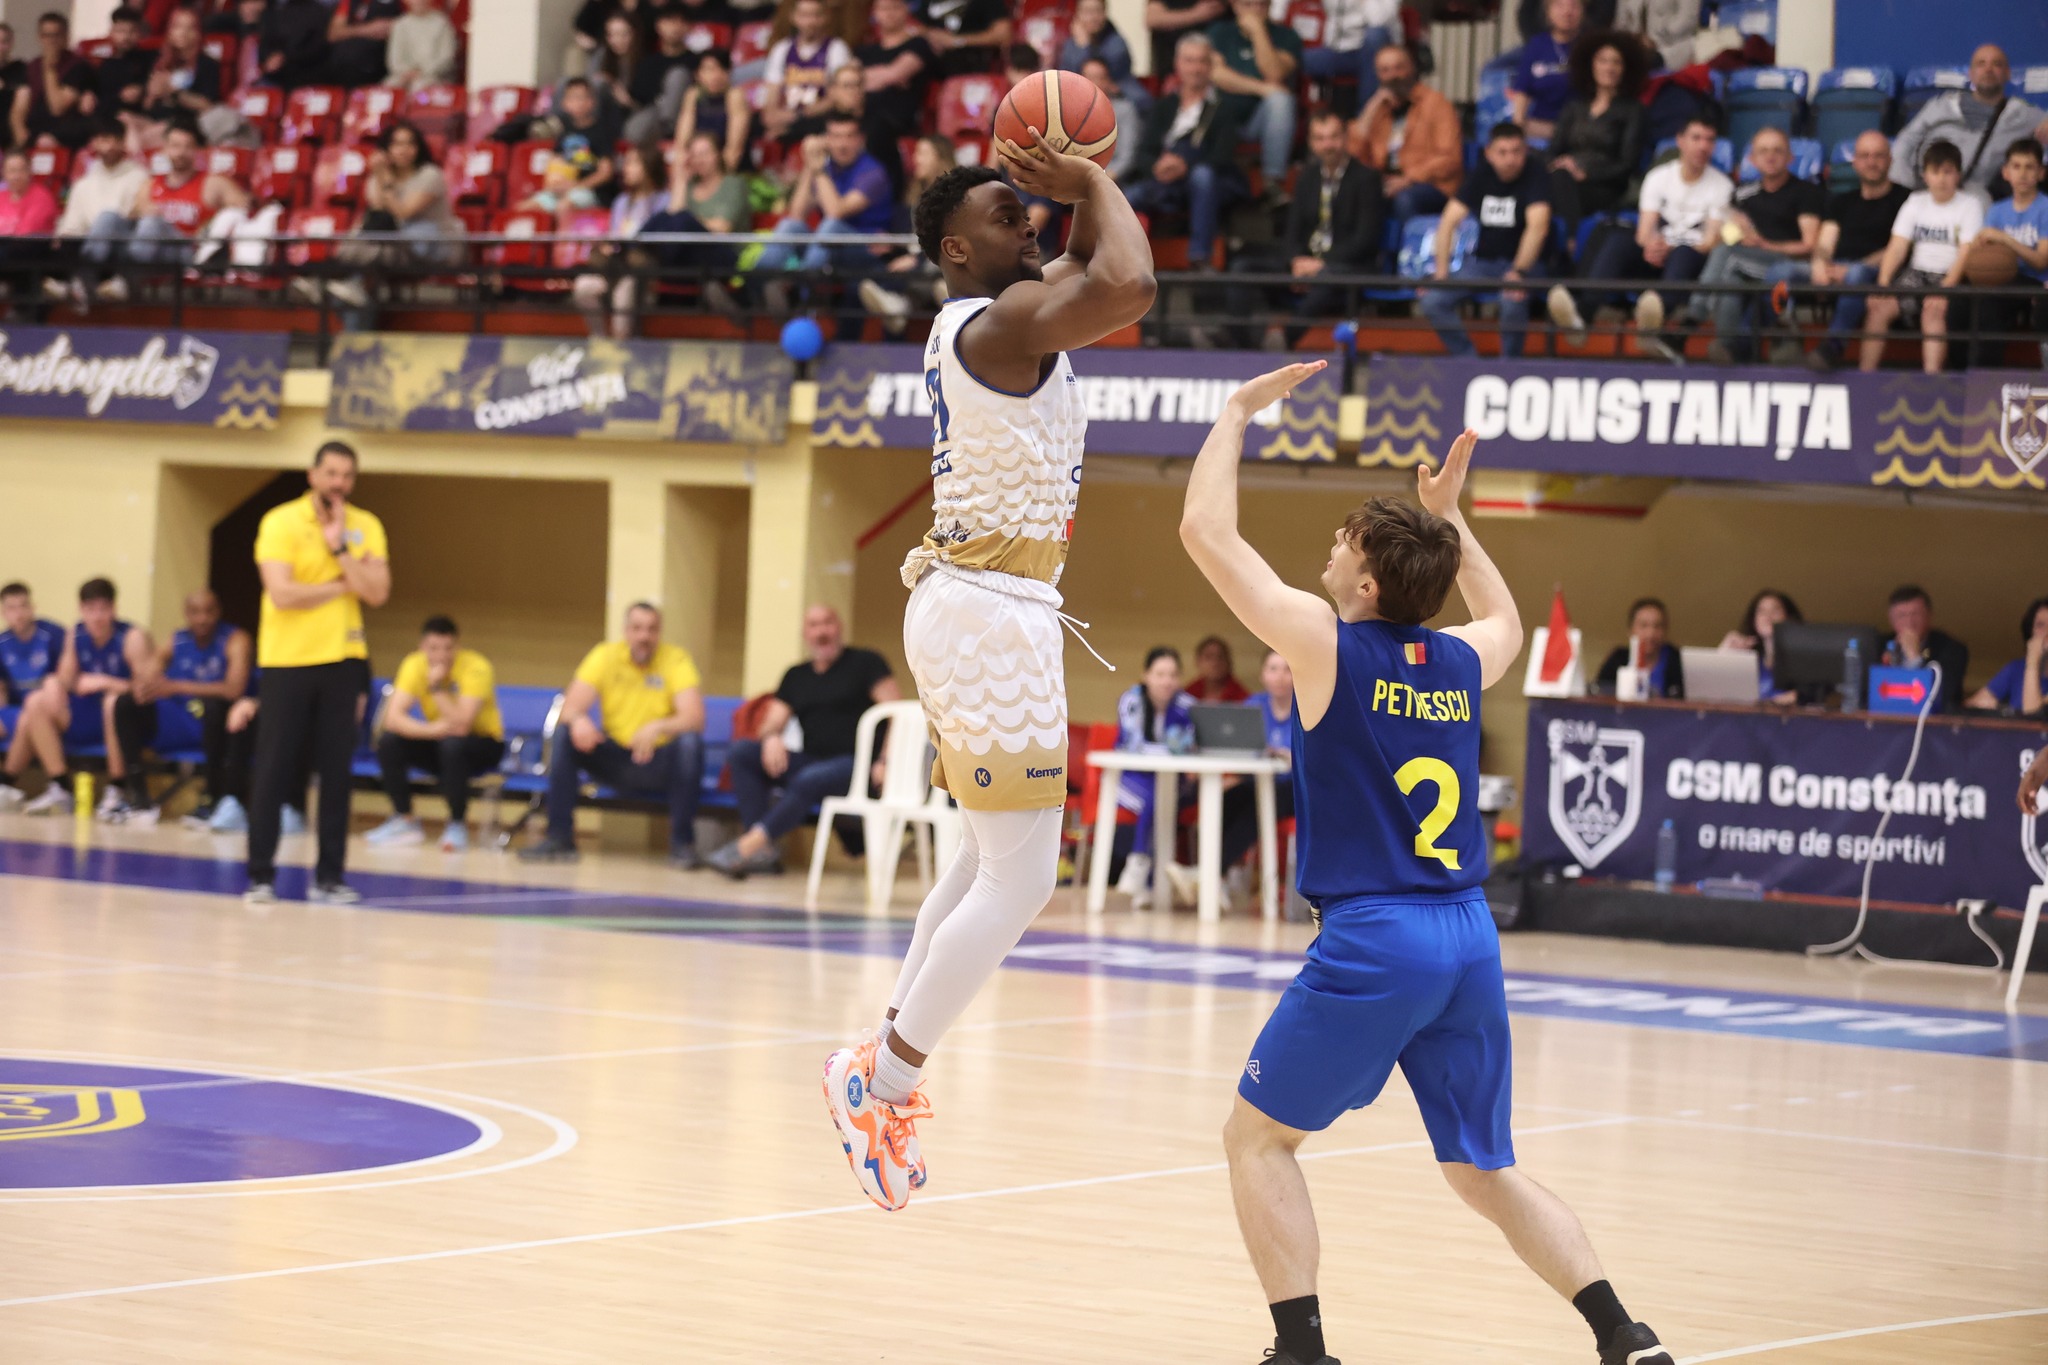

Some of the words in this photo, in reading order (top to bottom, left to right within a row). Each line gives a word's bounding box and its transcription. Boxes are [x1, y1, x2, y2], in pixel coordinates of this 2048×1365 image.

[1463, 374, 1852, 461] CONSTANȚA
[1371, 678, 1471, 723] PETRESCU
[1393, 756, 1462, 870] 2
[1665, 757, 1763, 804] CSM
[1768, 764, 1987, 826] Constanța
[1720, 824, 1795, 856] mare
[1799, 826, 1830, 859] de
[1836, 833, 1947, 867] sportivi
